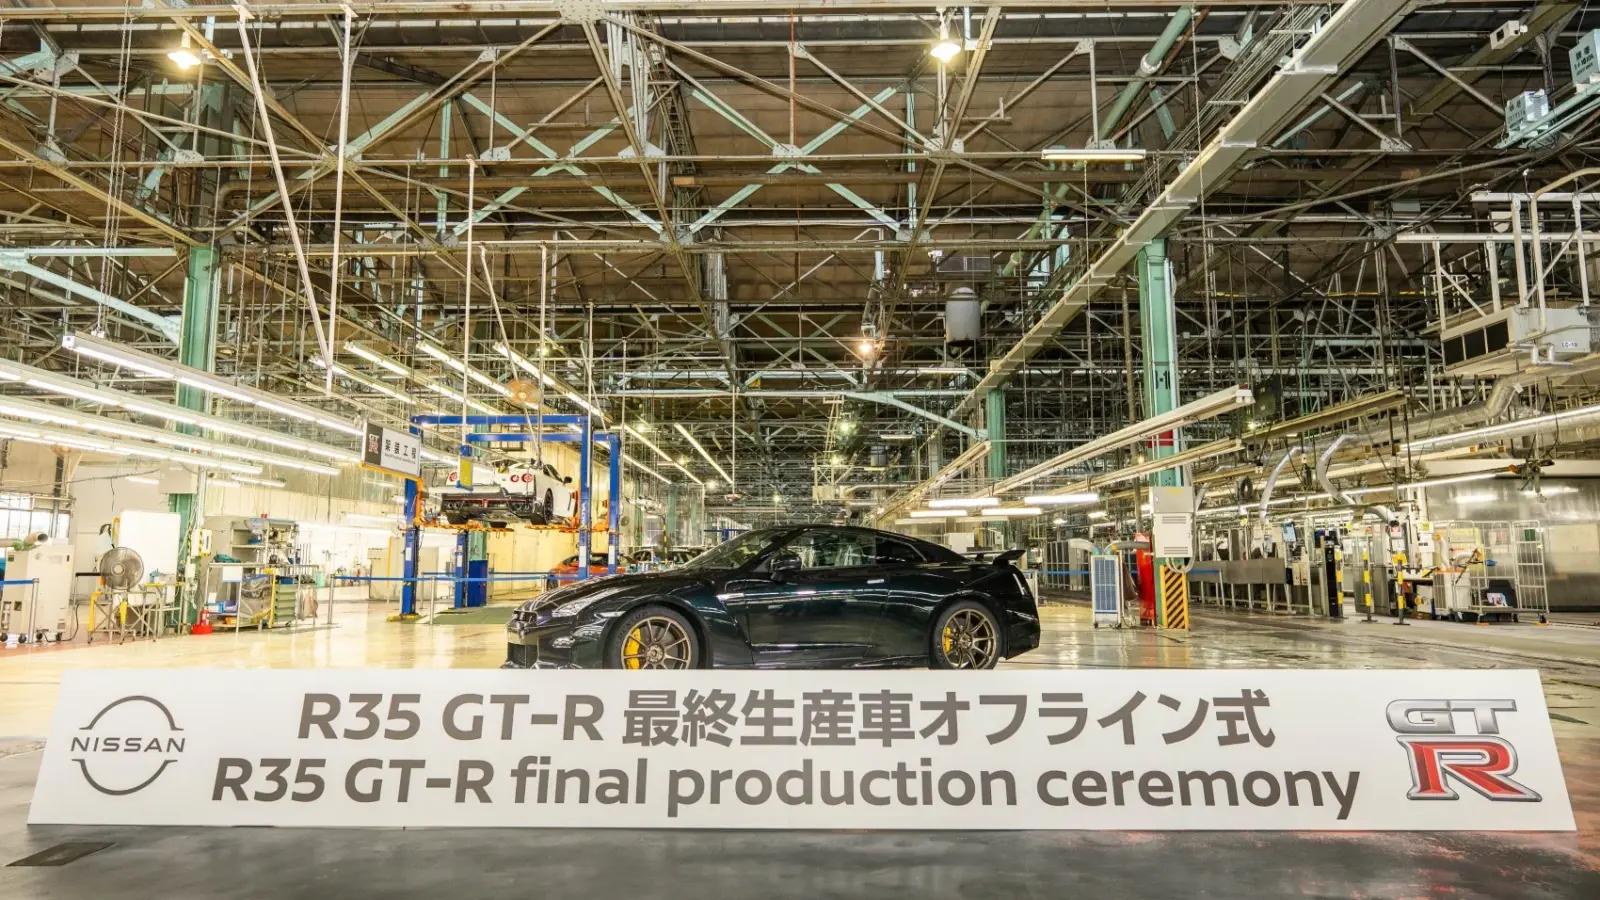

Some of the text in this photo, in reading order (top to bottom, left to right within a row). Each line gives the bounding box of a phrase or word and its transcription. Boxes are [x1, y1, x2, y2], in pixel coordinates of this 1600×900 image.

[297, 688, 1276, 749] R35 GT-R 最終生産車オフライン式
[1386, 698, 1518, 735] GT
[70, 736, 186, 753] NISSAN
[211, 755, 1361, 821] R35 GT-R final production ceremony
